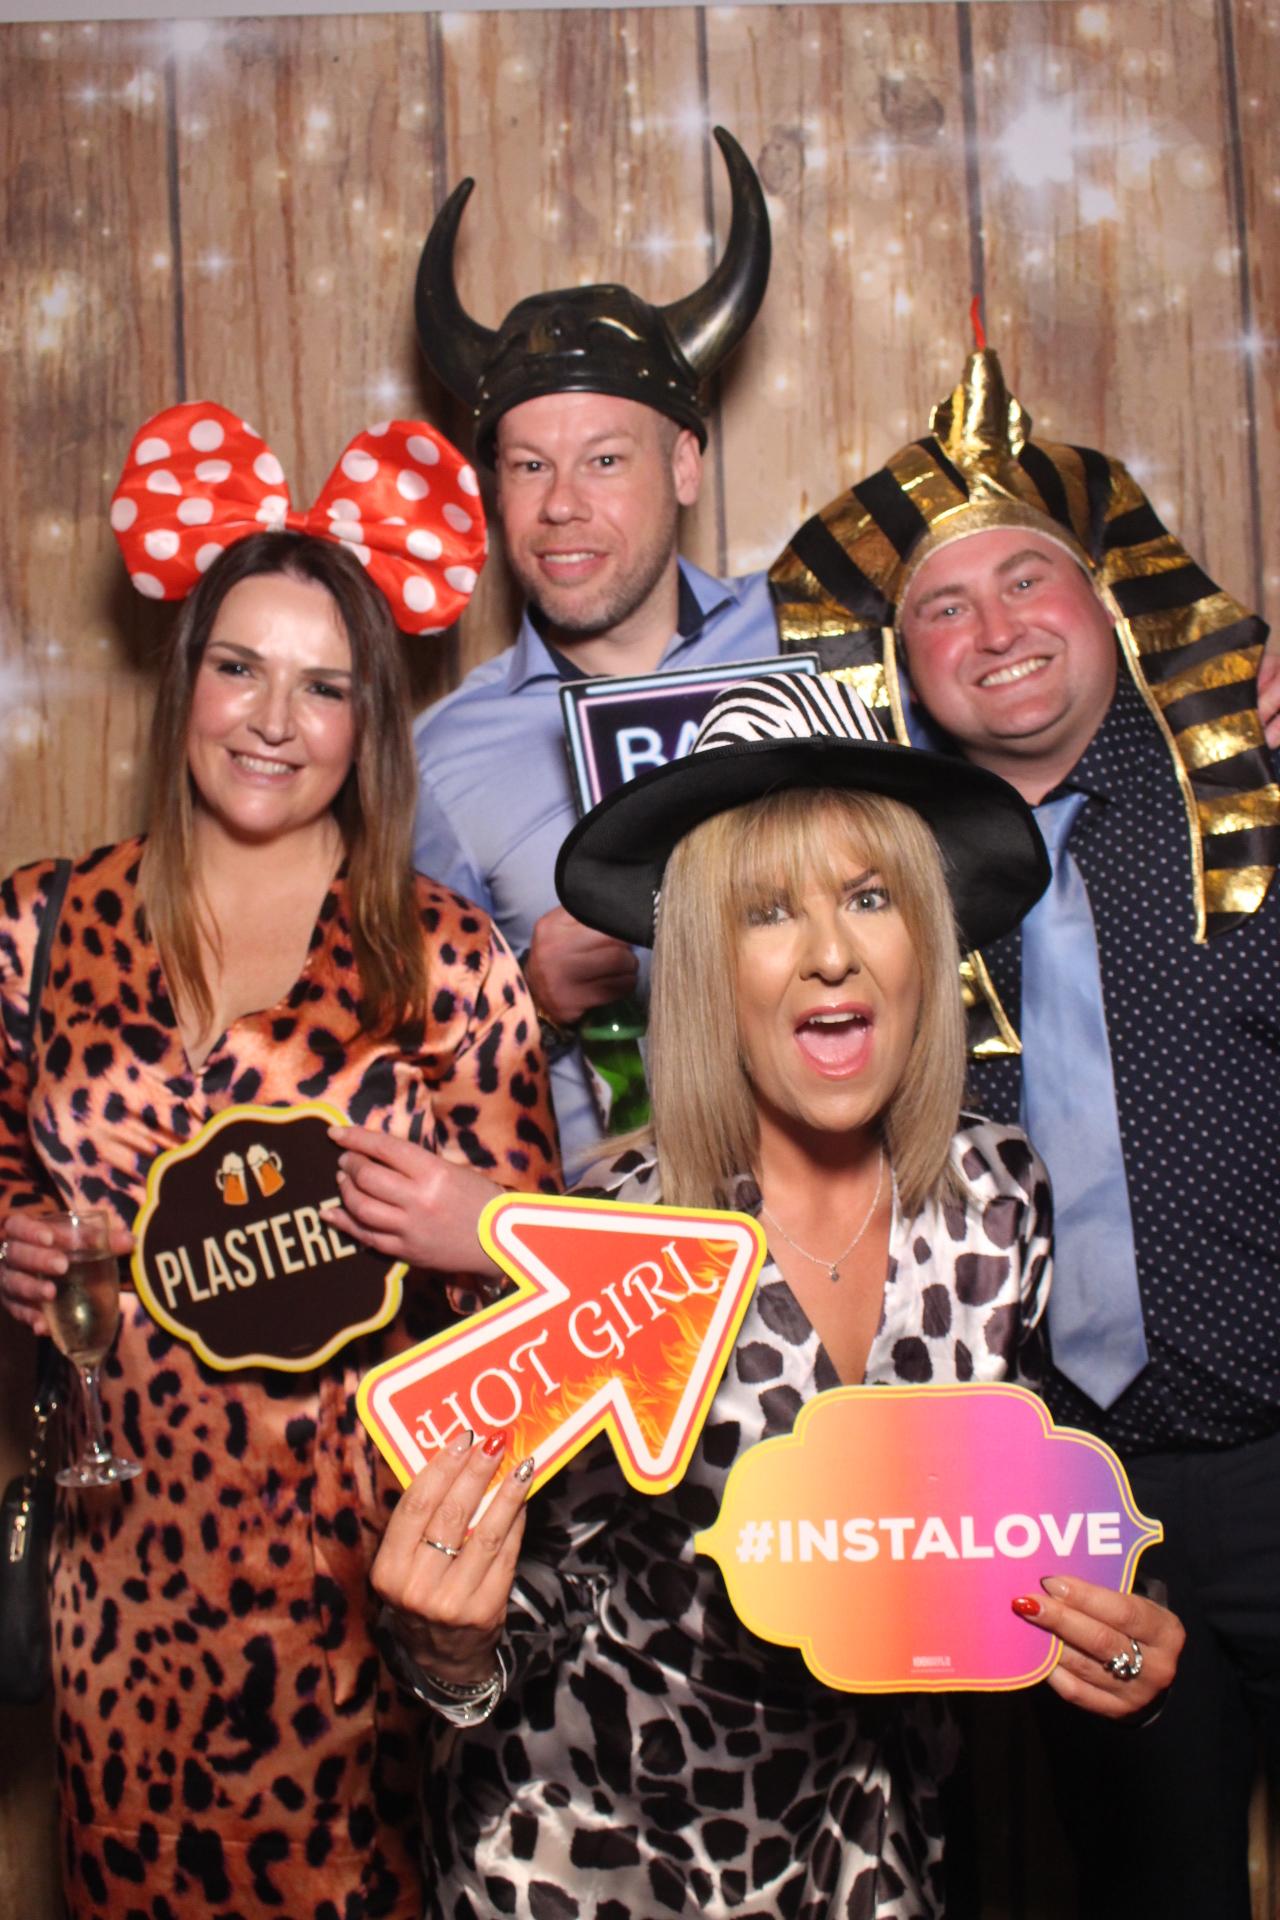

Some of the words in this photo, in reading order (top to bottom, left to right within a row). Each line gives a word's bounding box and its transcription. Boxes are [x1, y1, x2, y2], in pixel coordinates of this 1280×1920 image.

[155, 1196, 357, 1309] PLASTERE
[415, 1329, 561, 1449] HOT
[567, 1241, 721, 1361] GIRL
[735, 1512, 1123, 1563] #INSTALOVE
